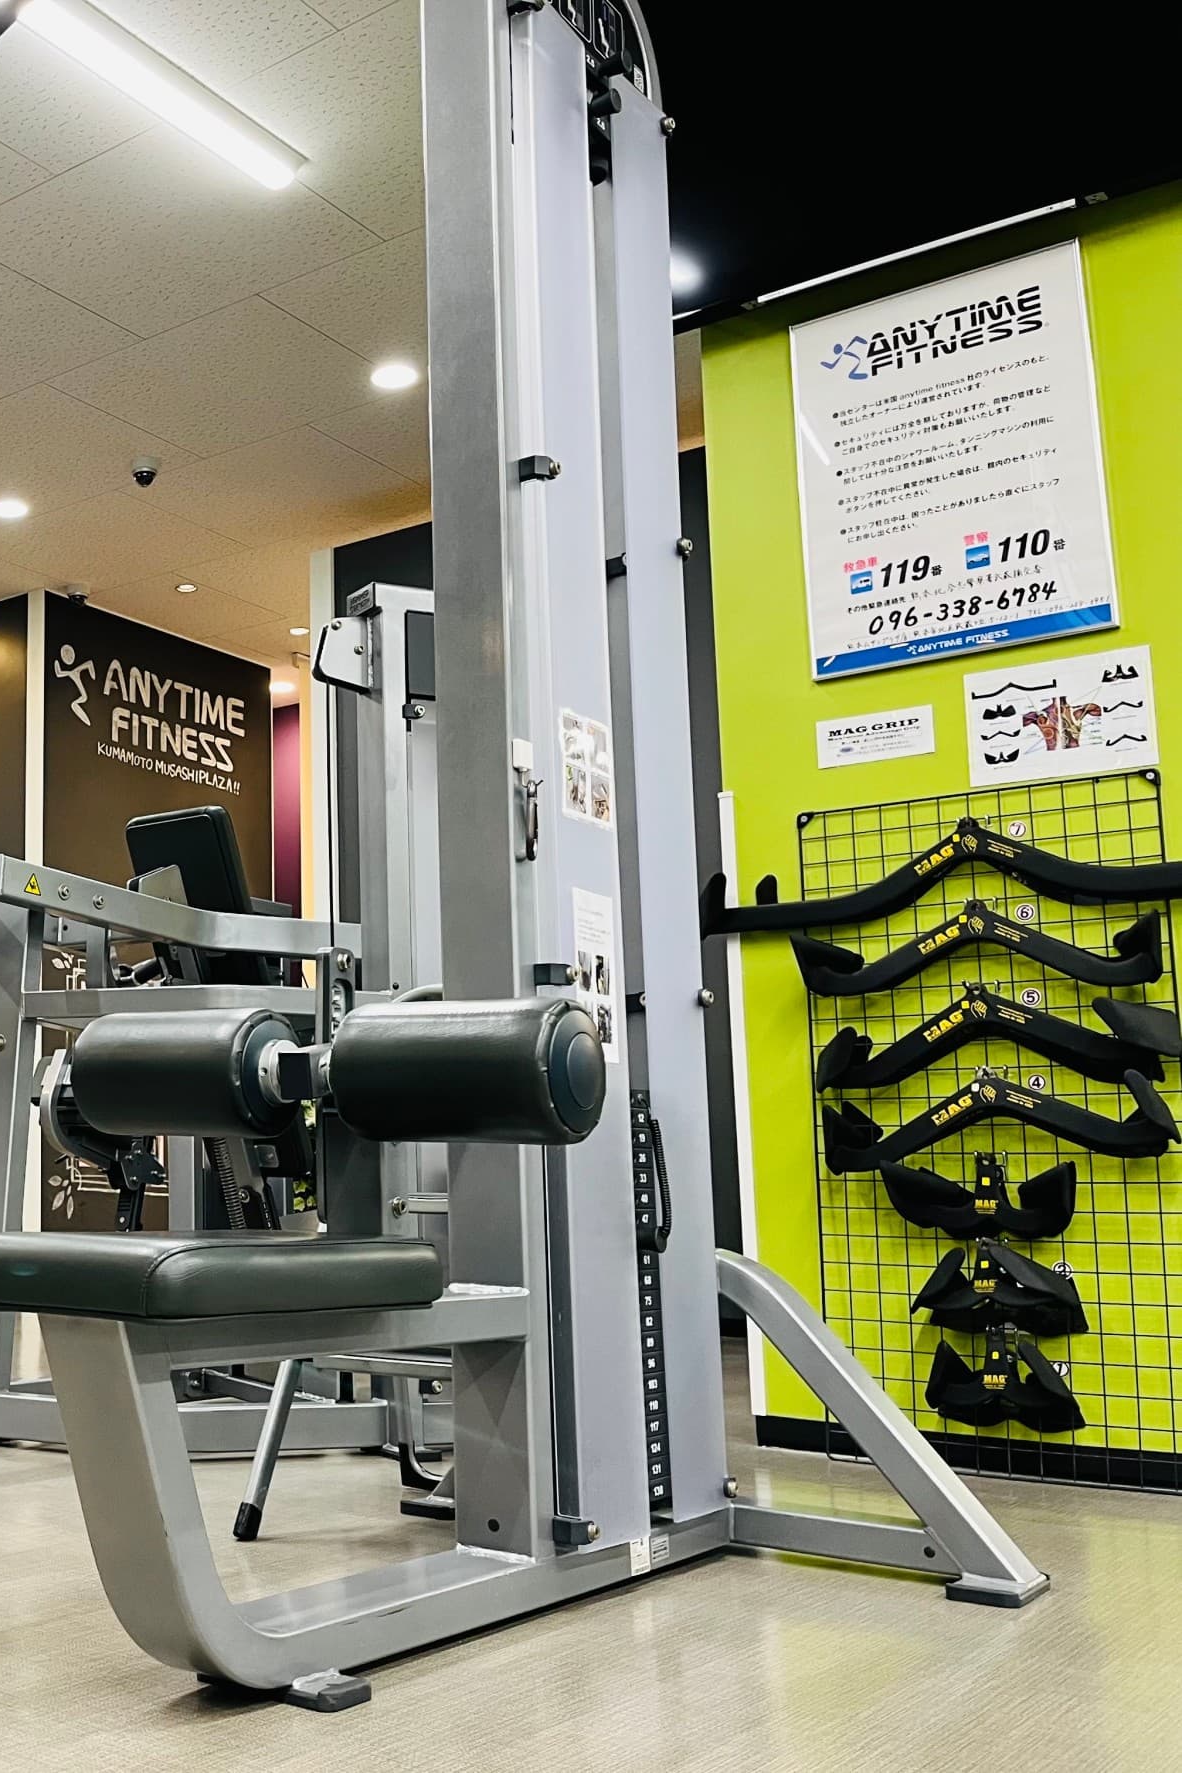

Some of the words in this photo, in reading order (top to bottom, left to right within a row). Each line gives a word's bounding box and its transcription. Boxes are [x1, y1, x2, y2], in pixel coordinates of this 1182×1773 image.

[865, 285, 1042, 357] ANYTIME
[870, 311, 1043, 376] FITNESS
[900, 386, 934, 400] anytime
[936, 377, 965, 390] fitness
[868, 579, 1057, 635] 096-338-6784
[918, 637, 962, 653] ANYTIME
[966, 628, 1009, 644] FITNESS
[103, 658, 246, 737] ANYTIME
[111, 706, 234, 773] FITNESS
[828, 726, 867, 737] MAG
[871, 718, 919, 731] GRIP
[97, 741, 153, 771] KUMAMOTO
[974, 1199, 997, 1210] MAG
[974, 1279, 996, 1289] MAG
[982, 1374, 1006, 1385] MAG
